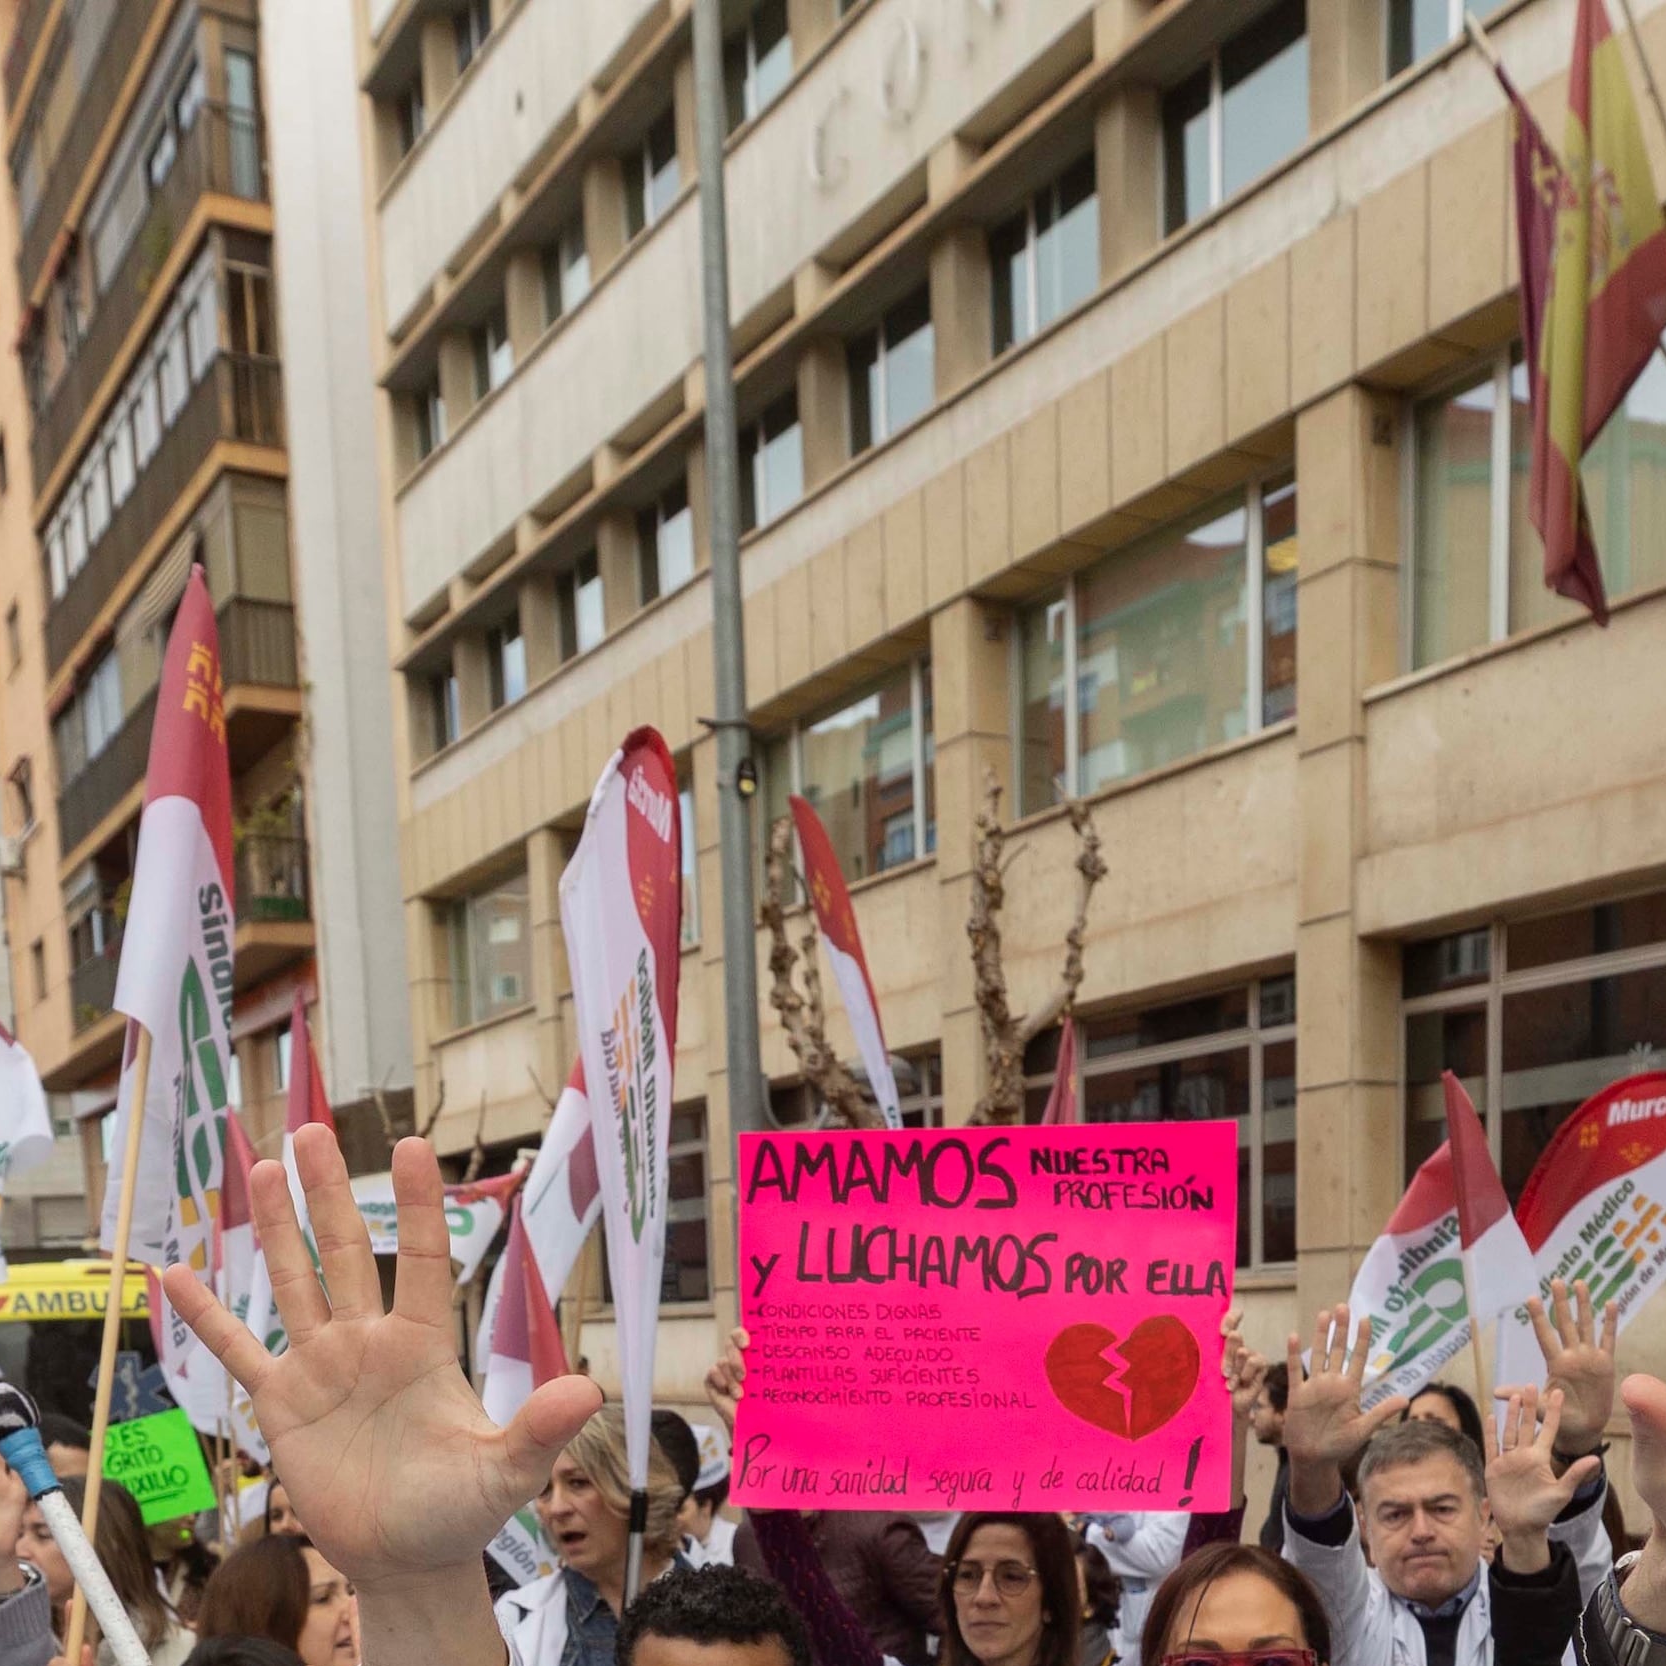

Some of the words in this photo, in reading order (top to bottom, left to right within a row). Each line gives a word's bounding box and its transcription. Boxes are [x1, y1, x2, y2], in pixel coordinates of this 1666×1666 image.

[746, 1137, 1018, 1208] AMAMOS
[1030, 1148, 1170, 1177] NUESTRA
[1053, 1176, 1215, 1211] PROFESIÓN
[1579, 1179, 1636, 1245] Médico
[796, 1221, 1059, 1299] LUCHAMOS
[1064, 1254, 1128, 1296] POR
[1146, 1260, 1228, 1296] ELLA
[1639, 1264, 1657, 1286] de
[876, 1303, 942, 1320] DIGNAS
[825, 1325, 865, 1340] PARA
[874, 1325, 894, 1341] EL
[762, 1344, 851, 1360] DESCANSO
[864, 1346, 953, 1362] ADECUADO
[763, 1365, 857, 1383] PLANTILLAS
[905, 1391, 1036, 1410] PROFESIONAL
[120, 1423, 149, 1448] ES
[106, 1445, 164, 1476] GRITO
[738, 1433, 776, 1489] Por
[782, 1463, 818, 1495] una
[827, 1456, 909, 1496] sanidad
[929, 1470, 992, 1506] segura
[1012, 1470, 1025, 1508] y
[1040, 1457, 1065, 1489] de
